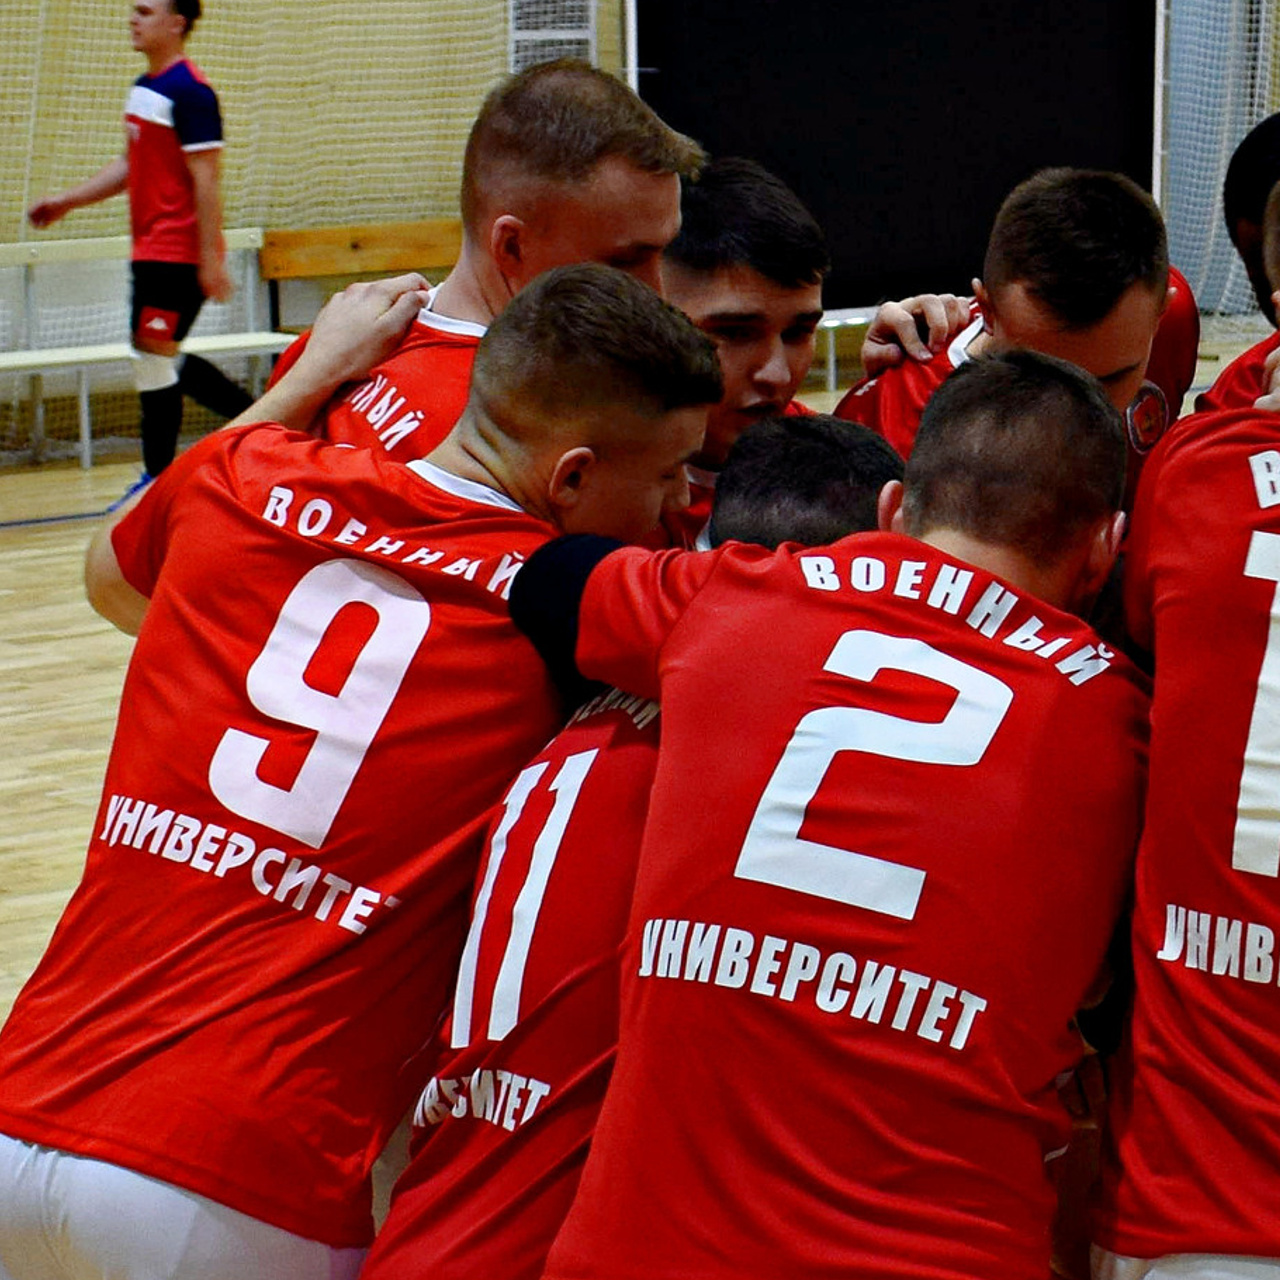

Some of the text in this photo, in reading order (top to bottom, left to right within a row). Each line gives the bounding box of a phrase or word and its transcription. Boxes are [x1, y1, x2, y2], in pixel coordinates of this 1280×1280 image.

[262, 486, 525, 601] ВОЕННЫЙ
[801, 557, 1116, 687] ВОЕННЫЙ
[208, 558, 431, 848] 9
[733, 629, 1014, 920] 2
[100, 795, 401, 935] УНИВЕРСИТЕ
[451, 748, 600, 1049] 11
[639, 920, 987, 1050] УНИВЕРСИТЕТ
